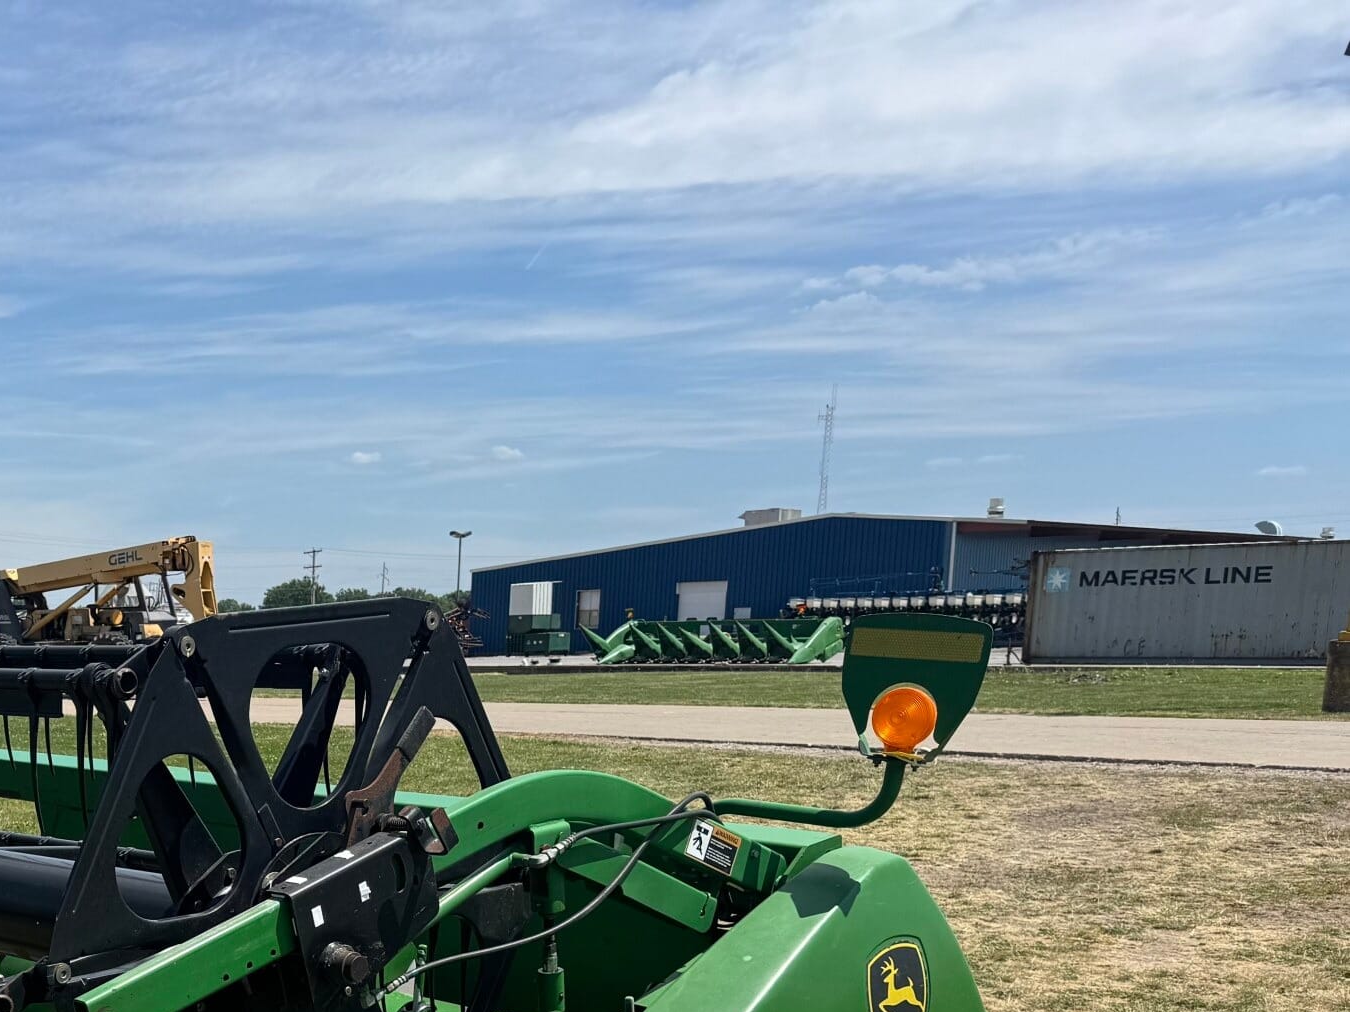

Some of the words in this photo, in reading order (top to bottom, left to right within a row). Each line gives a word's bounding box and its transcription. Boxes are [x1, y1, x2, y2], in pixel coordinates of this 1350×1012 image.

[108, 550, 143, 566] GEHL
[1078, 567, 1198, 588] MAERSK
[1203, 565, 1274, 585] LINE
